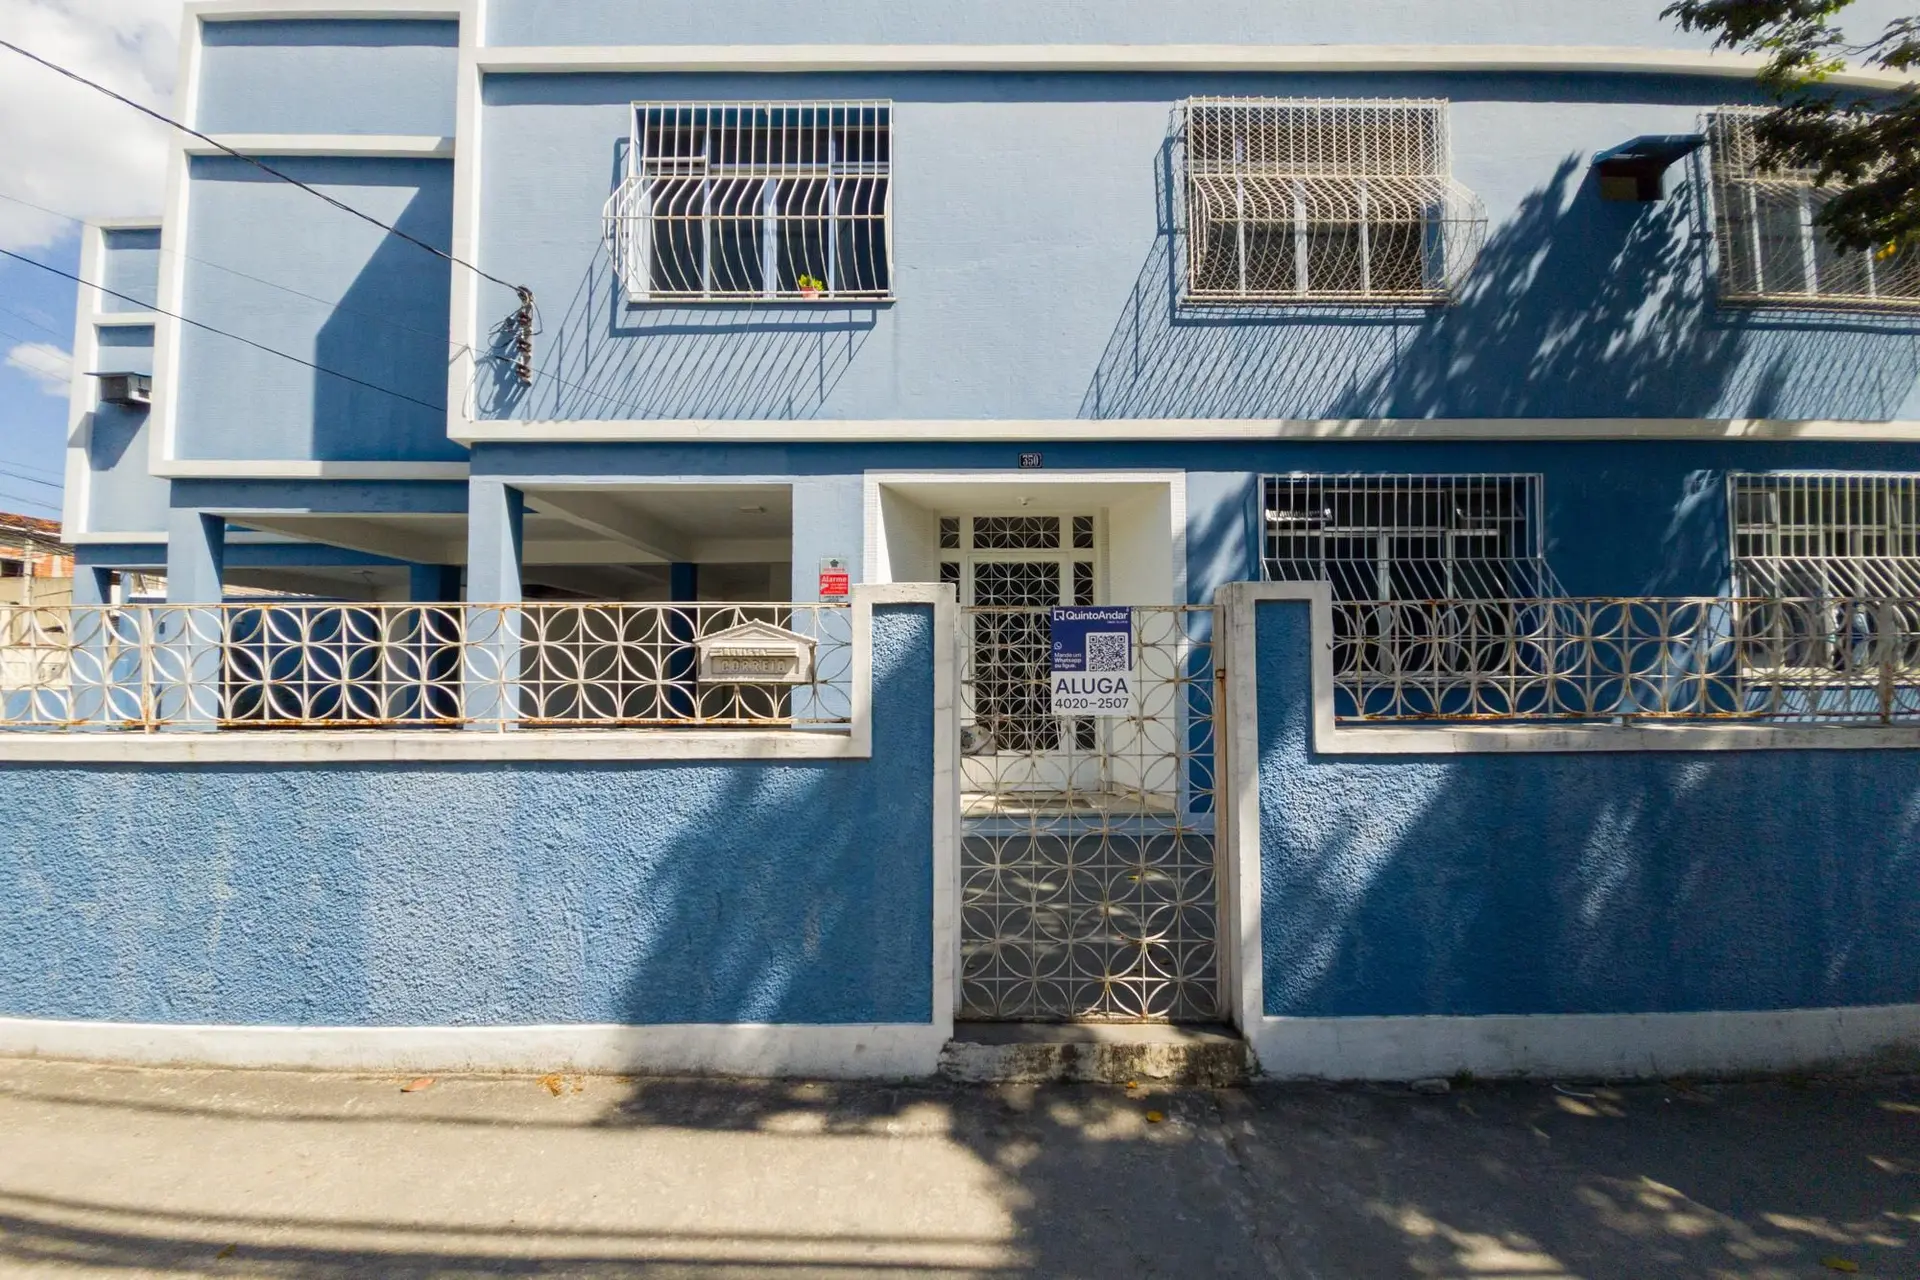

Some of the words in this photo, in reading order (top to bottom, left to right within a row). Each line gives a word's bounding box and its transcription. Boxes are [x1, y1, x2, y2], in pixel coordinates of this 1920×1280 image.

[1022, 454, 1039, 466] 350
[821, 575, 847, 583] Alarme
[1065, 610, 1129, 621] QuintoAndar
[721, 659, 786, 672] CORREIO
[1055, 677, 1129, 695] ALUGA
[1054, 697, 1130, 709] 4020-2507
